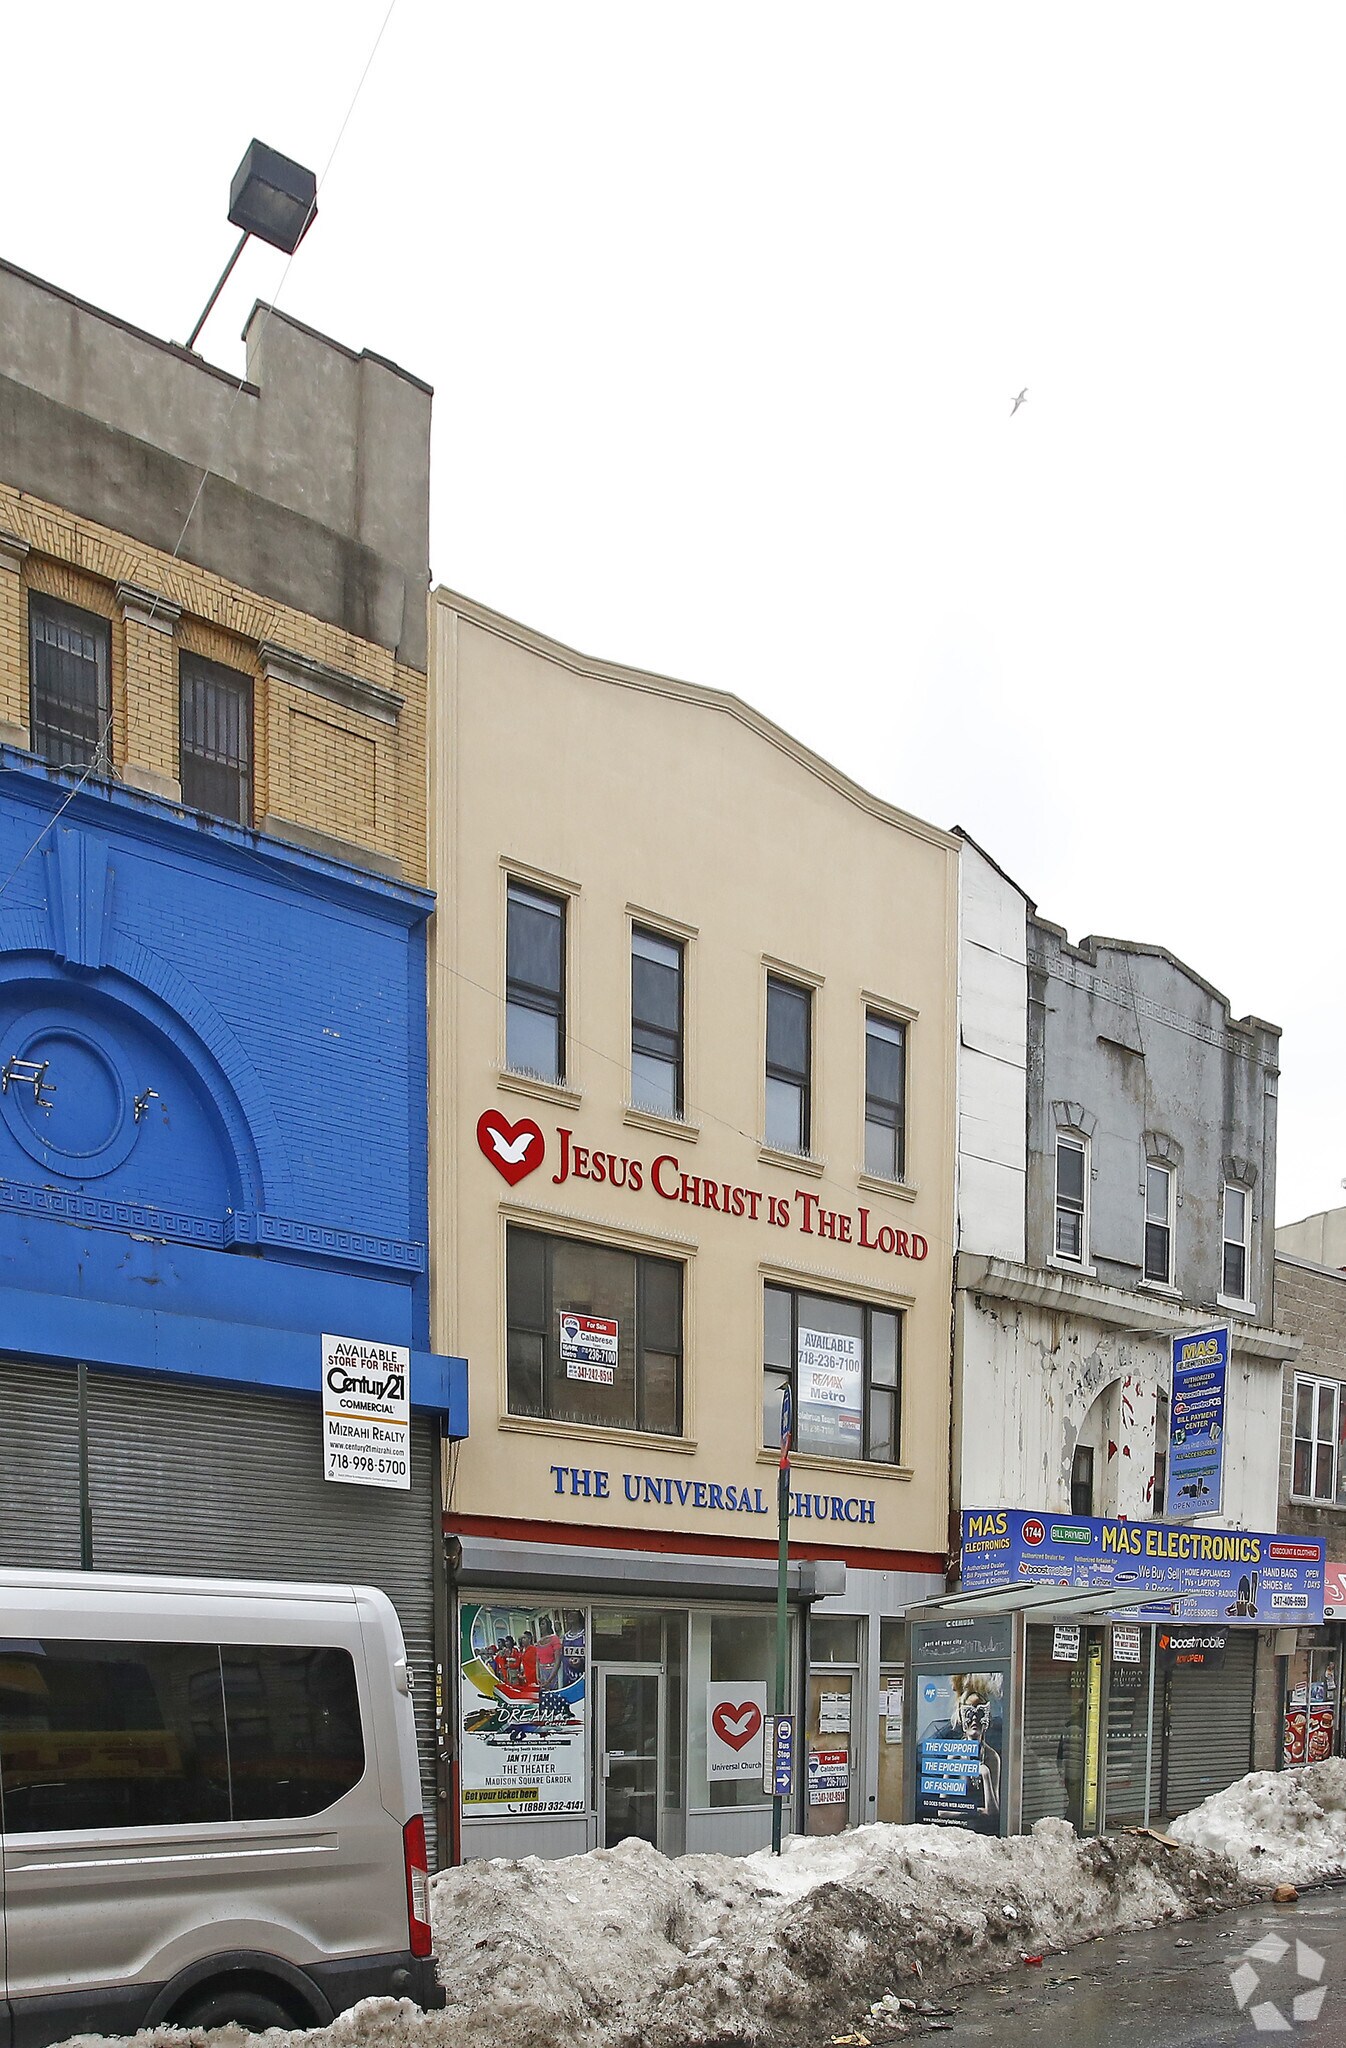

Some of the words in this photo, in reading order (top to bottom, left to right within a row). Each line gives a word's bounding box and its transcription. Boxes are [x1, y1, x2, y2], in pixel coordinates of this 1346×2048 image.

[580, 1332, 613, 1346] Calabrese
[804, 1333, 854, 1354] AVAILABLE
[335, 1343, 397, 1363] AVAILABLE
[1183, 1339, 1217, 1360] MAS
[328, 1355, 357, 1368] STORE
[361, 1360, 379, 1371] FOR
[382, 1363, 405, 1374] RENT
[798, 1350, 860, 1373] 718-236-7100
[812, 1373, 844, 1389] RE/MAX
[810, 1387, 845, 1403] Metro
[339, 1398, 394, 1414] COMMERCIAL
[1190, 1410, 1218, 1421] PAYMENT
[1185, 1420, 1209, 1430] CENTER
[329, 1442, 405, 1457] www.century21mizrahi.com
[329, 1453, 406, 1476] 718-998-5700
[550, 1465, 610, 1498] THE
[622, 1473, 769, 1514] UNIVERSAL
[1173, 1502, 1191, 1510] OPEN
[1197, 1499, 1215, 1507] DAYS
[968, 1512, 1008, 1538] MAS
[1024, 1527, 1042, 1538] 1744
[1052, 1529, 1064, 1539] BILL
[1064, 1530, 1090, 1541] PAYMENT
[965, 1538, 1010, 1553] ELECTRONICS
[1102, 1526, 1141, 1555] MAS
[1146, 1529, 1261, 1563] ELECTRONICS
[1272, 1547, 1293, 1555] DISCOUNT
[1296, 1549, 1317, 1557] CLOTHING
[990, 1561, 1006, 1569] Dealer
[994, 1568, 1009, 1576] Center
[1138, 1564, 1151, 1578] We
[1151, 1565, 1165, 1582] Buy,
[1167, 1567, 1180, 1580] Sell
[1184, 1569, 1200, 1577] HOME
[1200, 1569, 1231, 1578] APPLIANCES
[1262, 1567, 1280, 1578] HAND
[1280, 1568, 1298, 1579] BAGS
[1305, 1570, 1320, 1578] OPEN
[1198, 1579, 1220, 1587] LAPTOPS
[1262, 1580, 1283, 1590] SHOES
[1284, 1582, 1293, 1591] etc
[1307, 1581, 1321, 1589] DAYS
[1218, 1590, 1237, 1598] RADIOS
[1184, 1609, 1219, 1617] ACCESSORIES
[496, 1708, 554, 1722] DREAM
[778, 1741, 790, 1749] Bus
[925, 1742, 942, 1752] THEY
[942, 1743, 977, 1753] SUPPORT
[506, 1754, 520, 1762] JAN
[521, 1754, 528, 1762] 17
[533, 1753, 550, 1762] 11AM
[777, 1750, 791, 1760] Stop
[503, 1764, 518, 1774] THE
[521, 1764, 556, 1774] THEATER
[711, 1762, 740, 1771] Universal
[740, 1761, 762, 1770] Church
[925, 1761, 938, 1771] THE
[938, 1762, 978, 1773] EPICENTER
[485, 1777, 517, 1786] MADISON
[518, 1776, 544, 1786] SQUARE
[545, 1775, 572, 1784] GARDEN
[924, 1780, 934, 1790] OF
[933, 1781, 965, 1792] FASHION
[465, 1791, 478, 1801] Get
[479, 1791, 497, 1801] your
[497, 1790, 519, 1799] ticket
[519, 1789, 537, 1799] here
[547, 1800, 584, 1811] 332-4141
